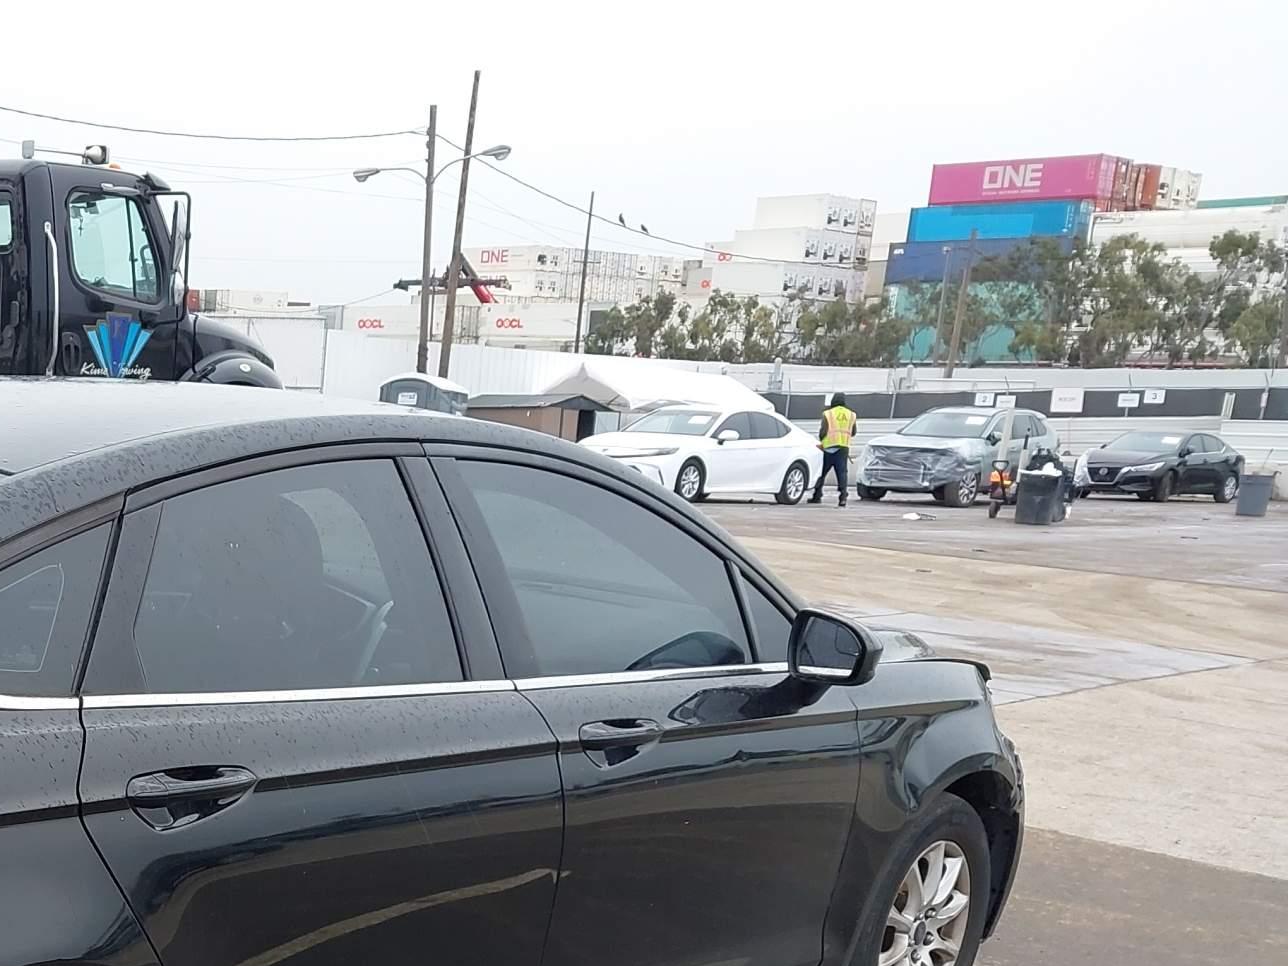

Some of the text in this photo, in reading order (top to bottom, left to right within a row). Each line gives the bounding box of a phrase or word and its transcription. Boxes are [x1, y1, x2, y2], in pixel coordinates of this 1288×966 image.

[982, 163, 1043, 189] ONE
[480, 249, 509, 264] ONE
[357, 318, 385, 329] OOCL
[495, 318, 524, 329] OOCL
